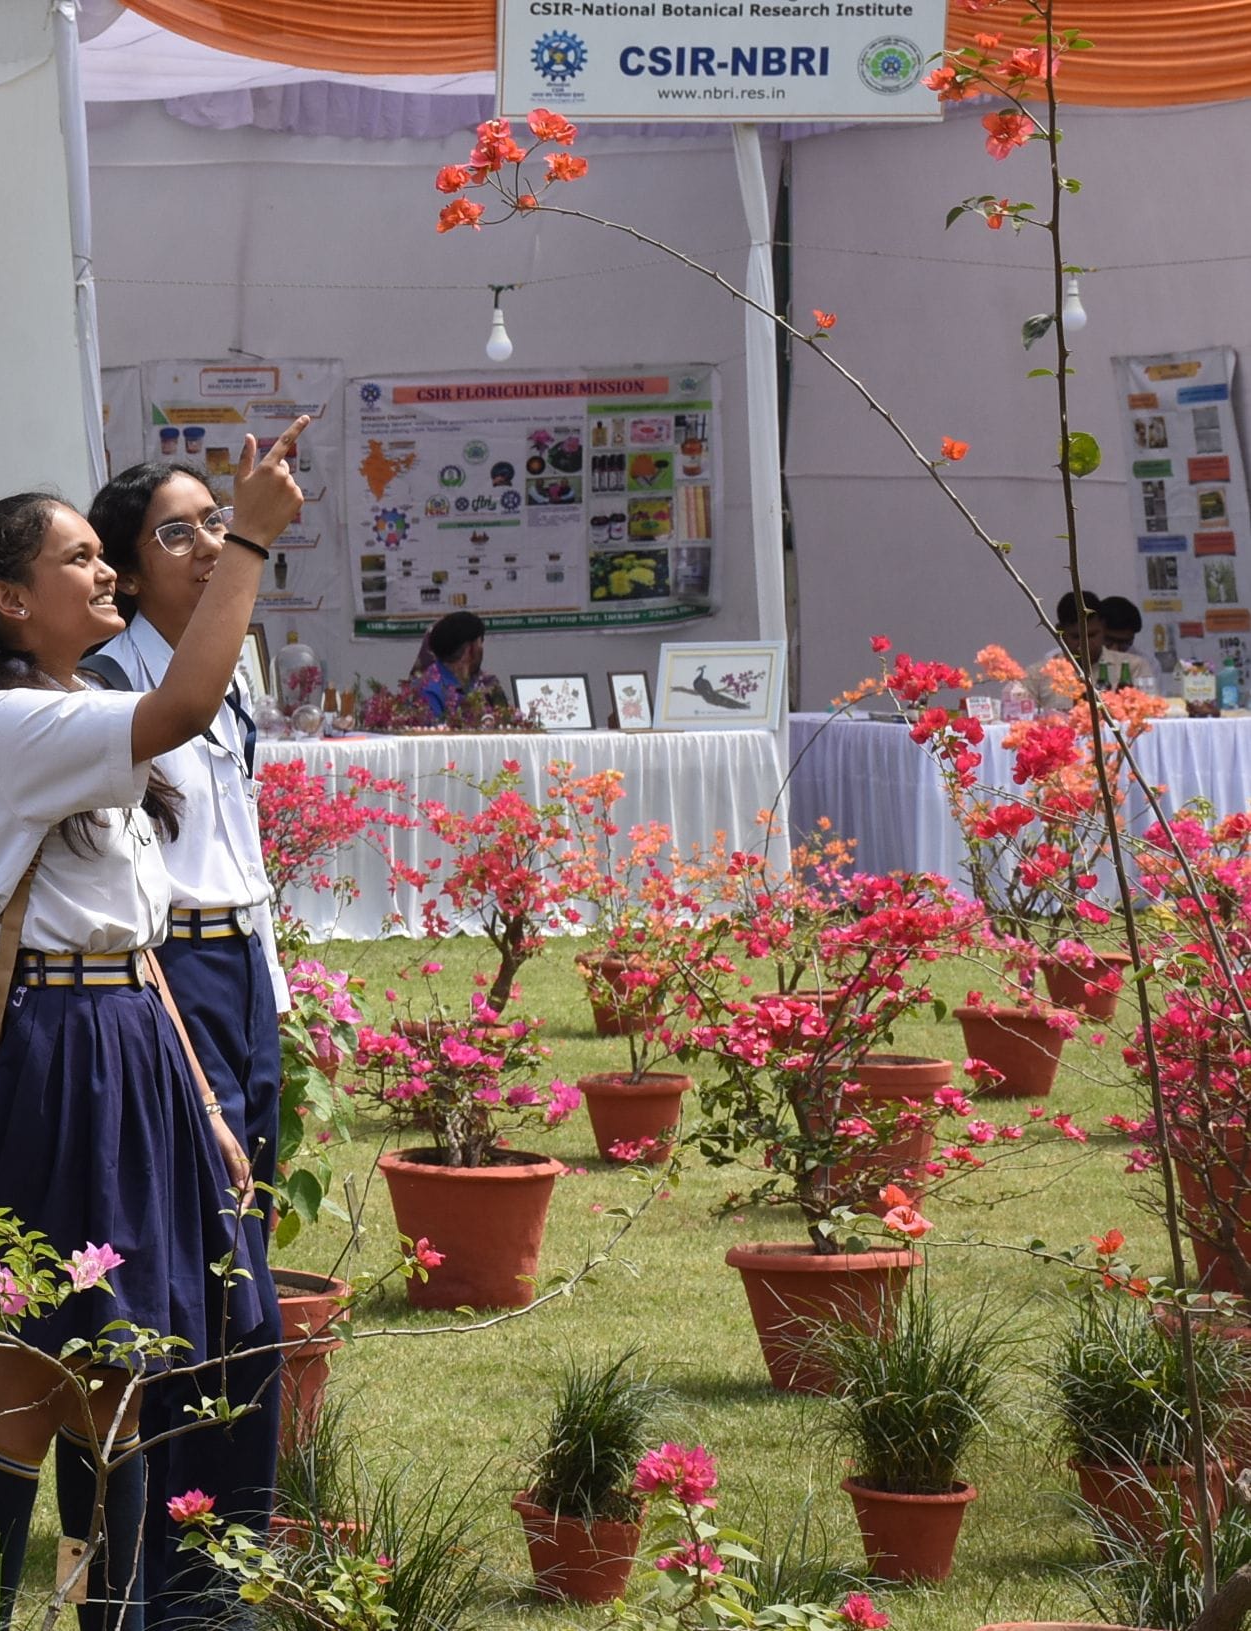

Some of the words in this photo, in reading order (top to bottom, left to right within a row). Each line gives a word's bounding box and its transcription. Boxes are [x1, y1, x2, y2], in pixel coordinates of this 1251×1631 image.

[529, 2, 655, 16] CSIR-National
[662, 3, 743, 17] Botanical
[749, 3, 830, 17] Research
[836, 3, 913, 17] Institute
[619, 46, 829, 77] CSIR-NBRI
[657, 86, 786, 100] www.nbri.res.in
[416, 388, 452, 402] CSIR
[456, 382, 574, 400] FLORICULTURE
[579, 379, 645, 395] MISSION
